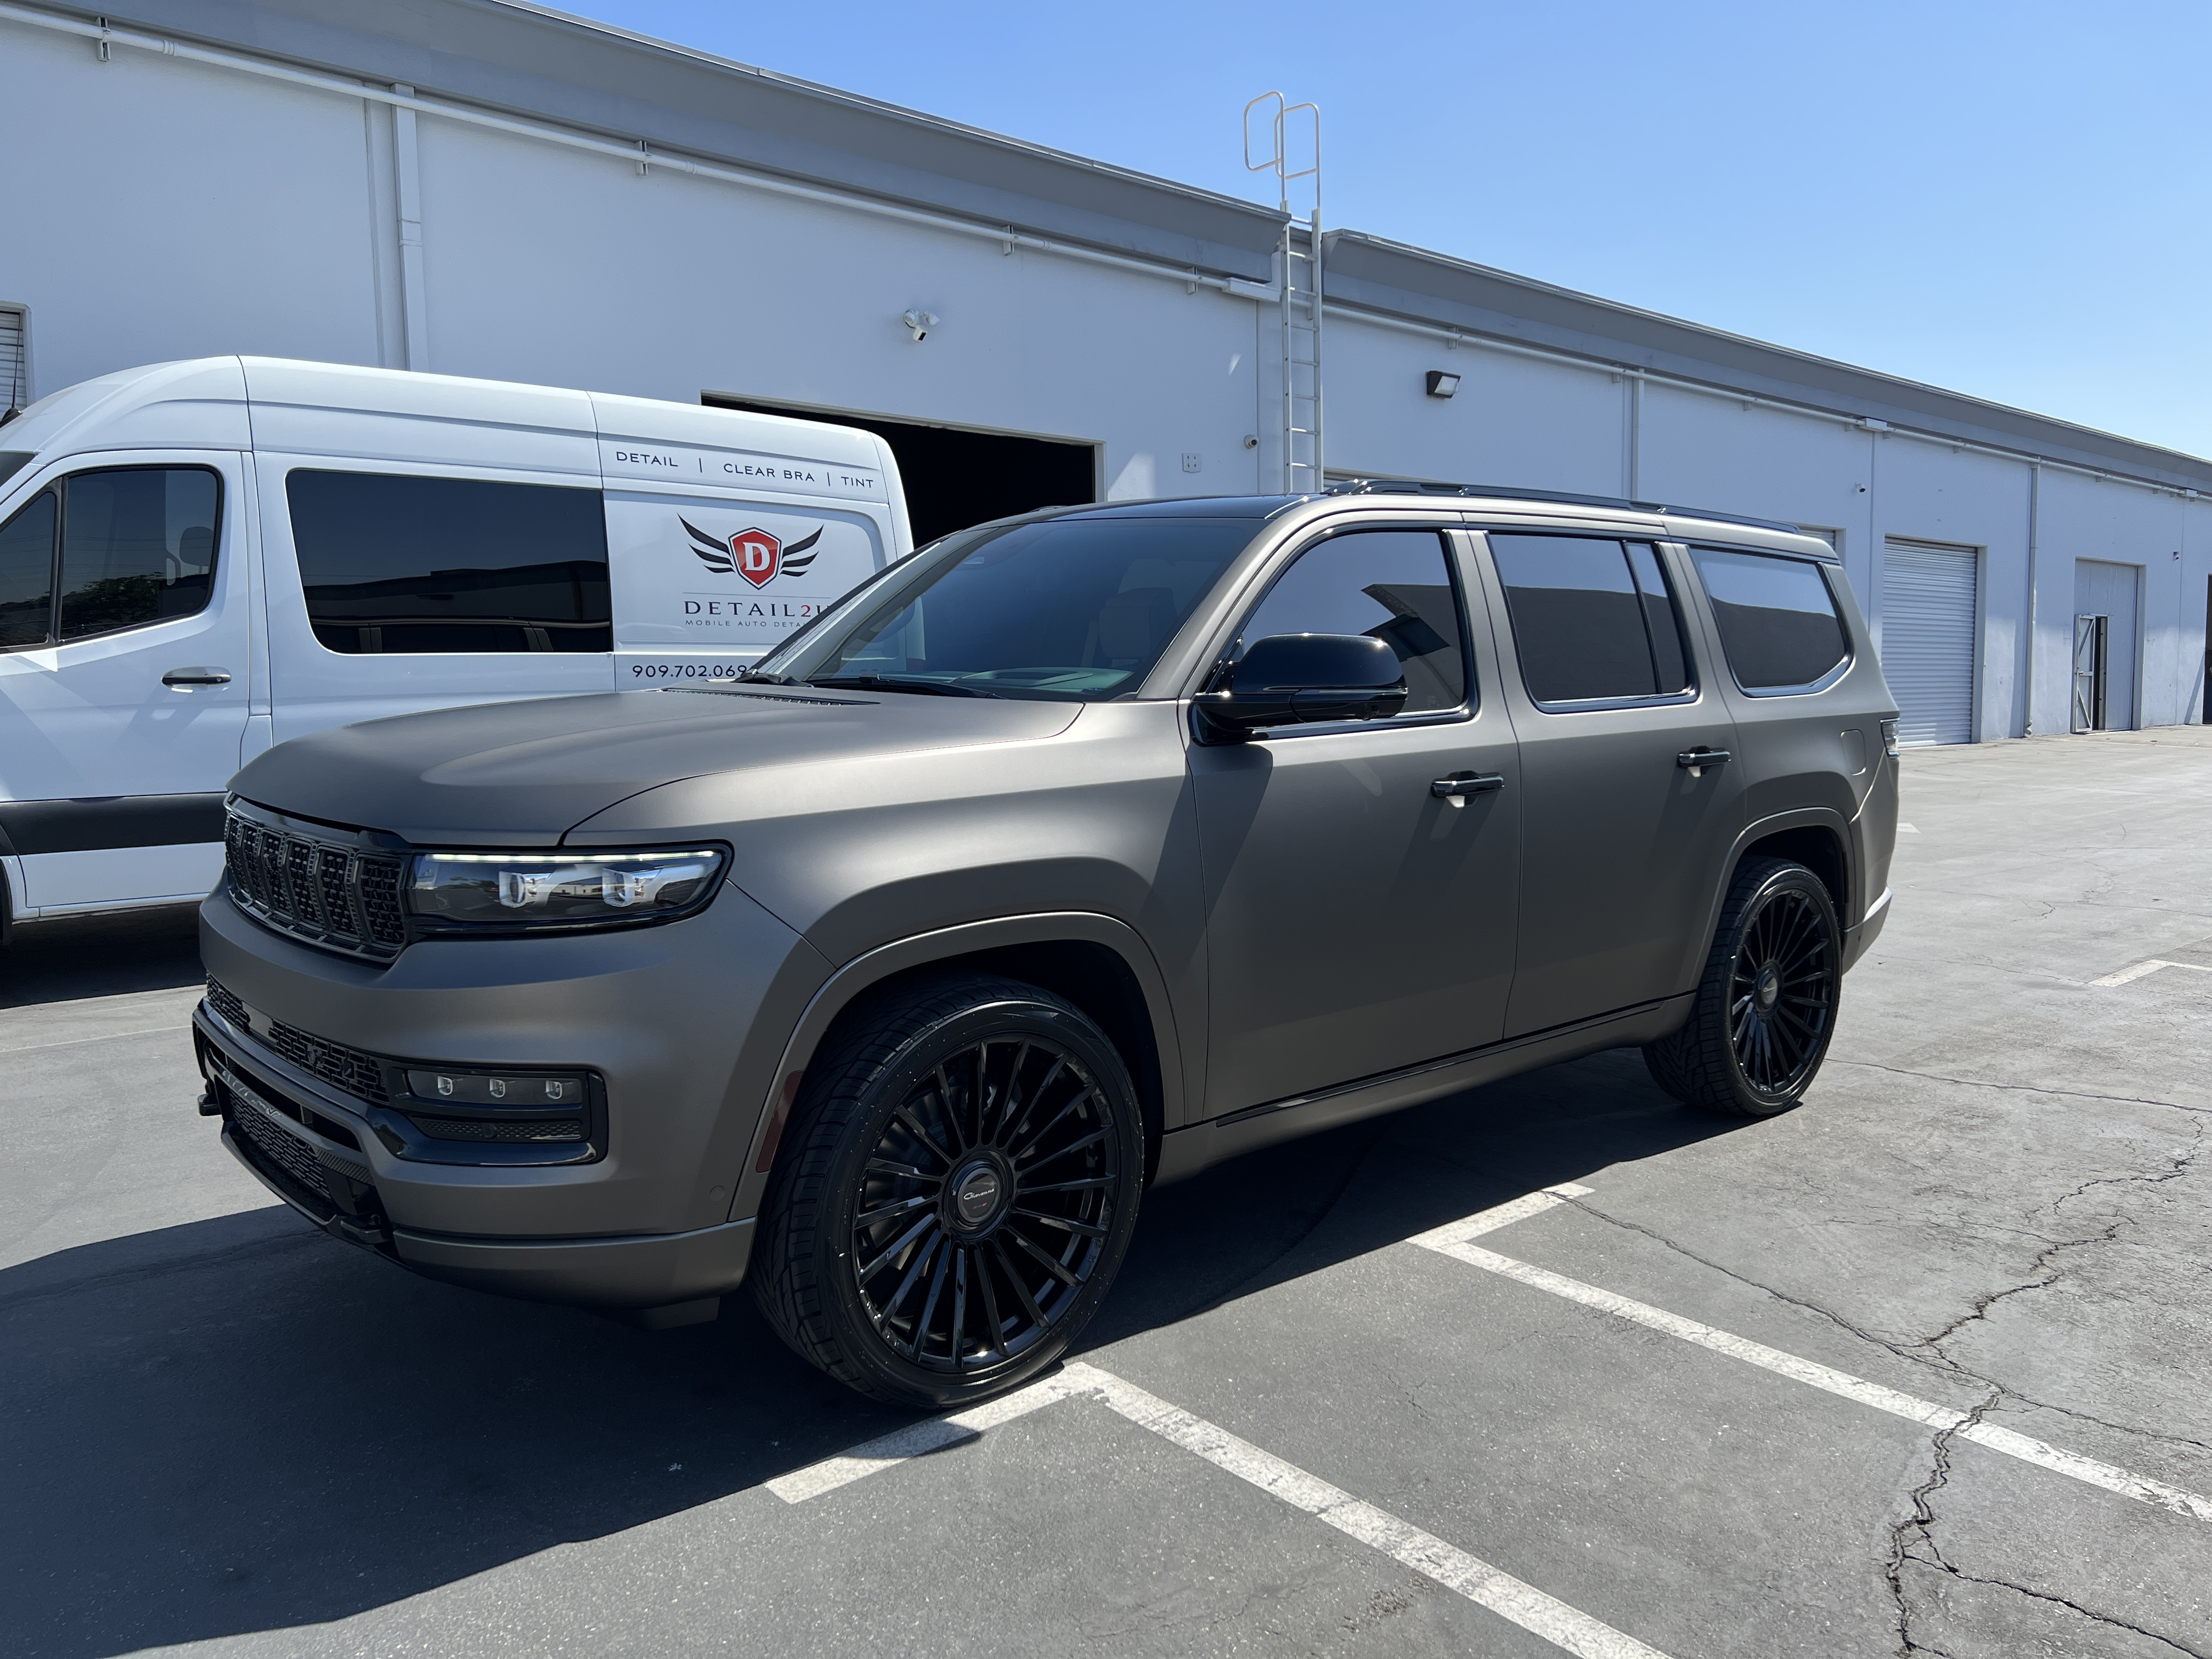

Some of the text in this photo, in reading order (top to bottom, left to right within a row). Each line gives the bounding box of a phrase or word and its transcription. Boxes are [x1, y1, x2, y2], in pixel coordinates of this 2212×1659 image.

[616, 451, 678, 467] DETAIL
[723, 463, 776, 478] CLEAR
[783, 470, 815, 482] BRA
[840, 476, 874, 488] TINT
[742, 541, 771, 571] D
[632, 664, 747, 678] 909.702.069
